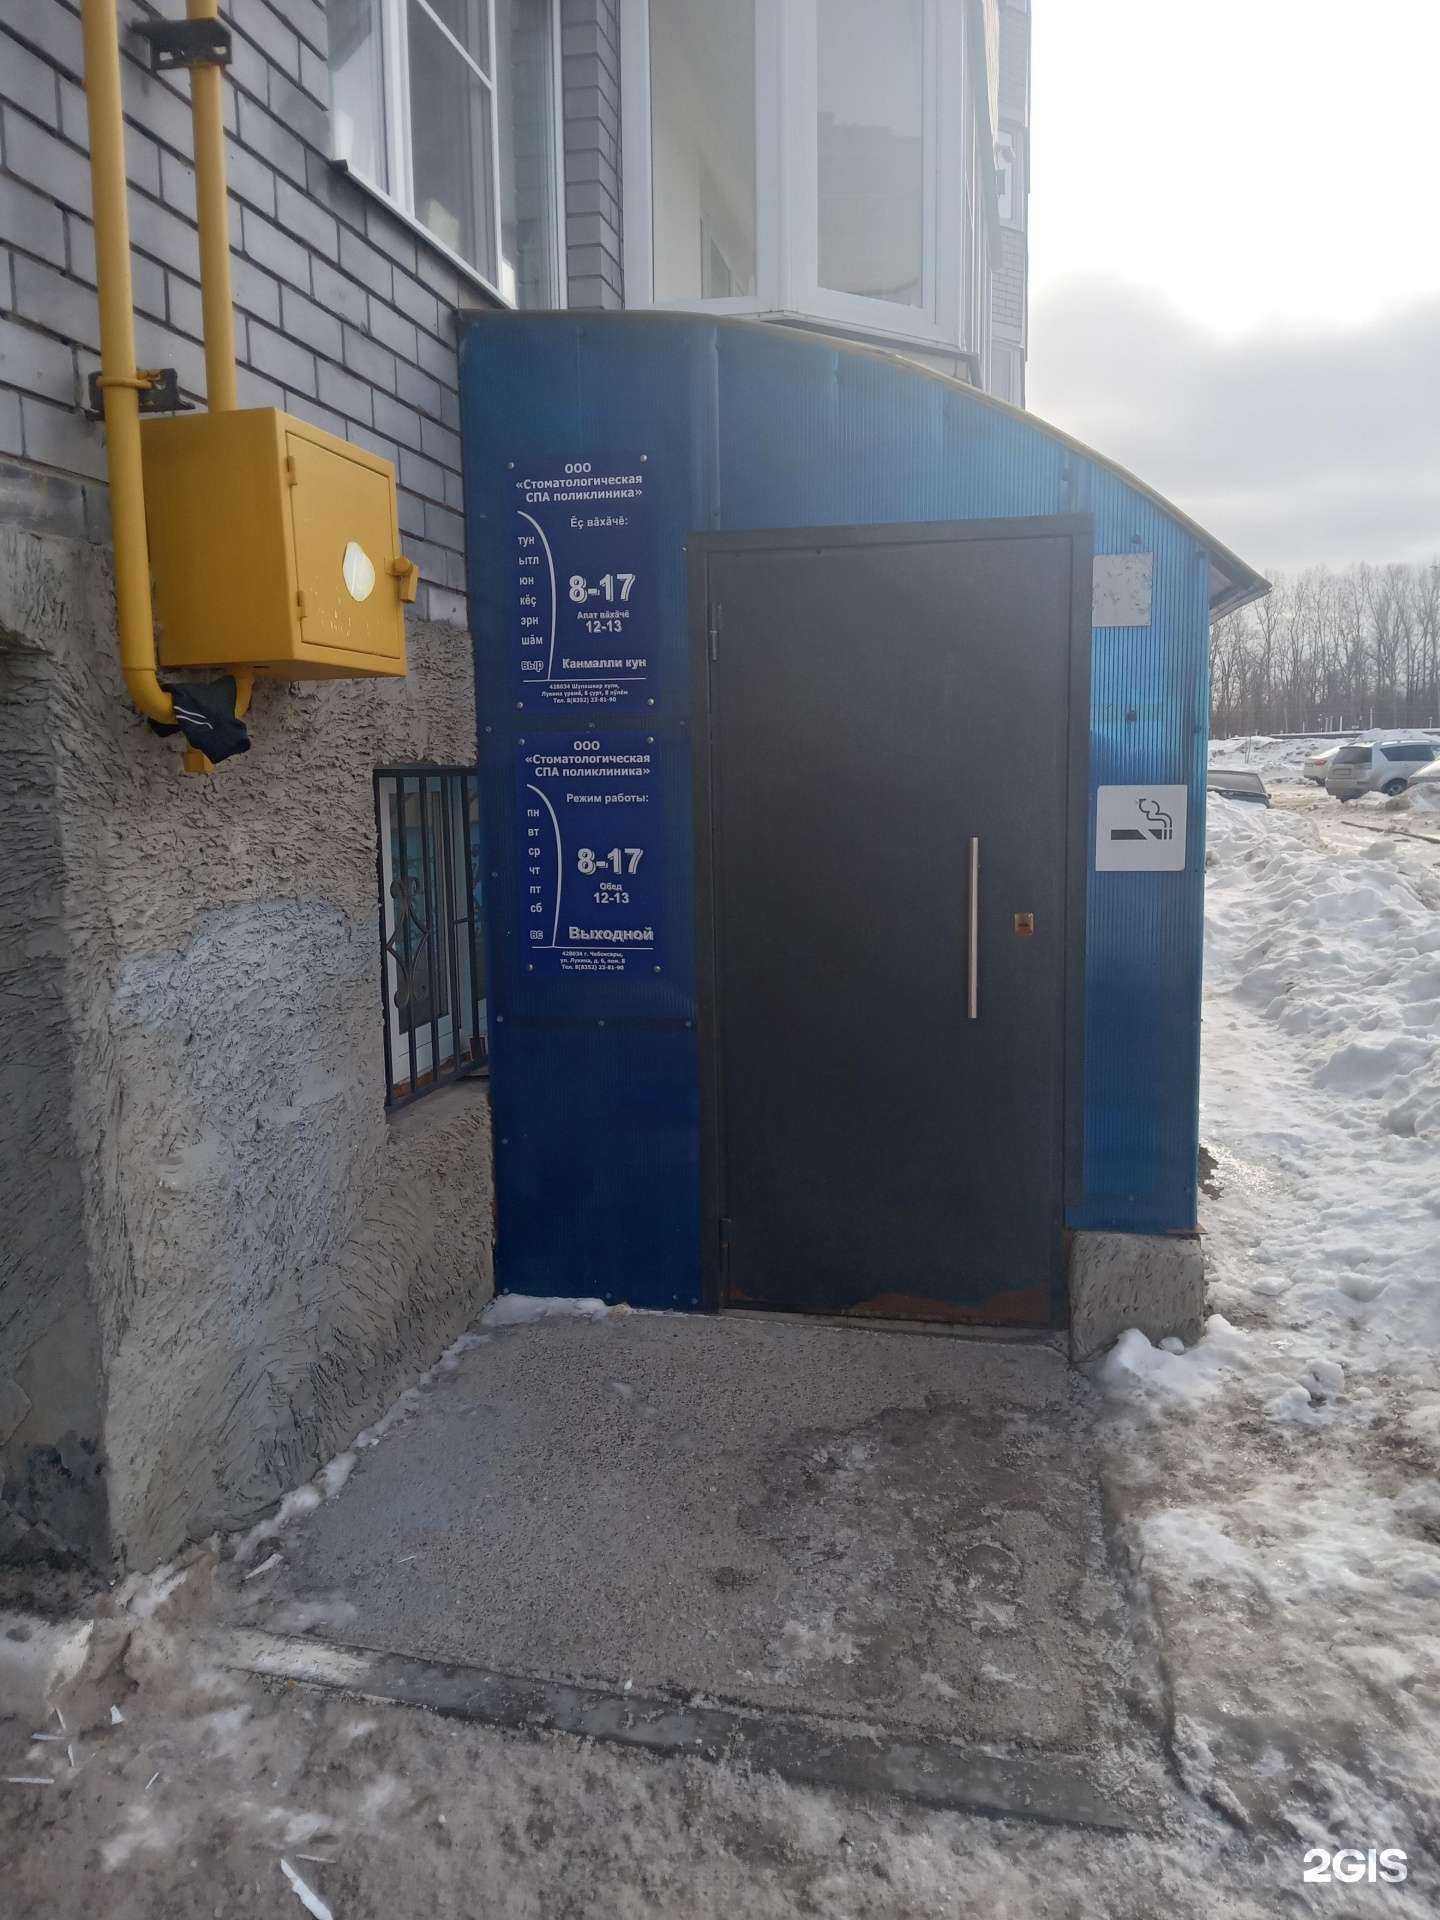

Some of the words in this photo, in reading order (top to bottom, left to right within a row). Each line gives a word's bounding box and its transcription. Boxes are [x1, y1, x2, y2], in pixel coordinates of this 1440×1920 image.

[564, 462, 592, 474] ООО
[516, 475, 643, 490] «Стоматологическая
[526, 491, 551, 503] СПА
[553, 490, 643, 502] поликлиника»
[518, 536, 535, 547] тун
[519, 556, 539, 565] ытл
[520, 577, 535, 585] юн
[569, 573, 636, 604] 8-17
[586, 619, 622, 633] 12-13
[573, 741, 600, 751] ООО
[525, 754, 650, 764] «Стоматологическая
[535, 767, 559, 777] СПА
[562, 767, 650, 776] поликлиника»
[566, 793, 601, 803] Режим
[605, 793, 649, 804] работы:
[527, 828, 540, 837] вт
[528, 848, 541, 858] ср
[577, 847, 644, 875] 8-17
[529, 866, 541, 876] чт
[529, 885, 541, 894] пт
[599, 882, 622, 892] Обед
[593, 892, 630, 904] 12-13
[530, 903, 543, 913] сб
[529, 930, 544, 940] вс
[568, 926, 654, 942] Выходной
